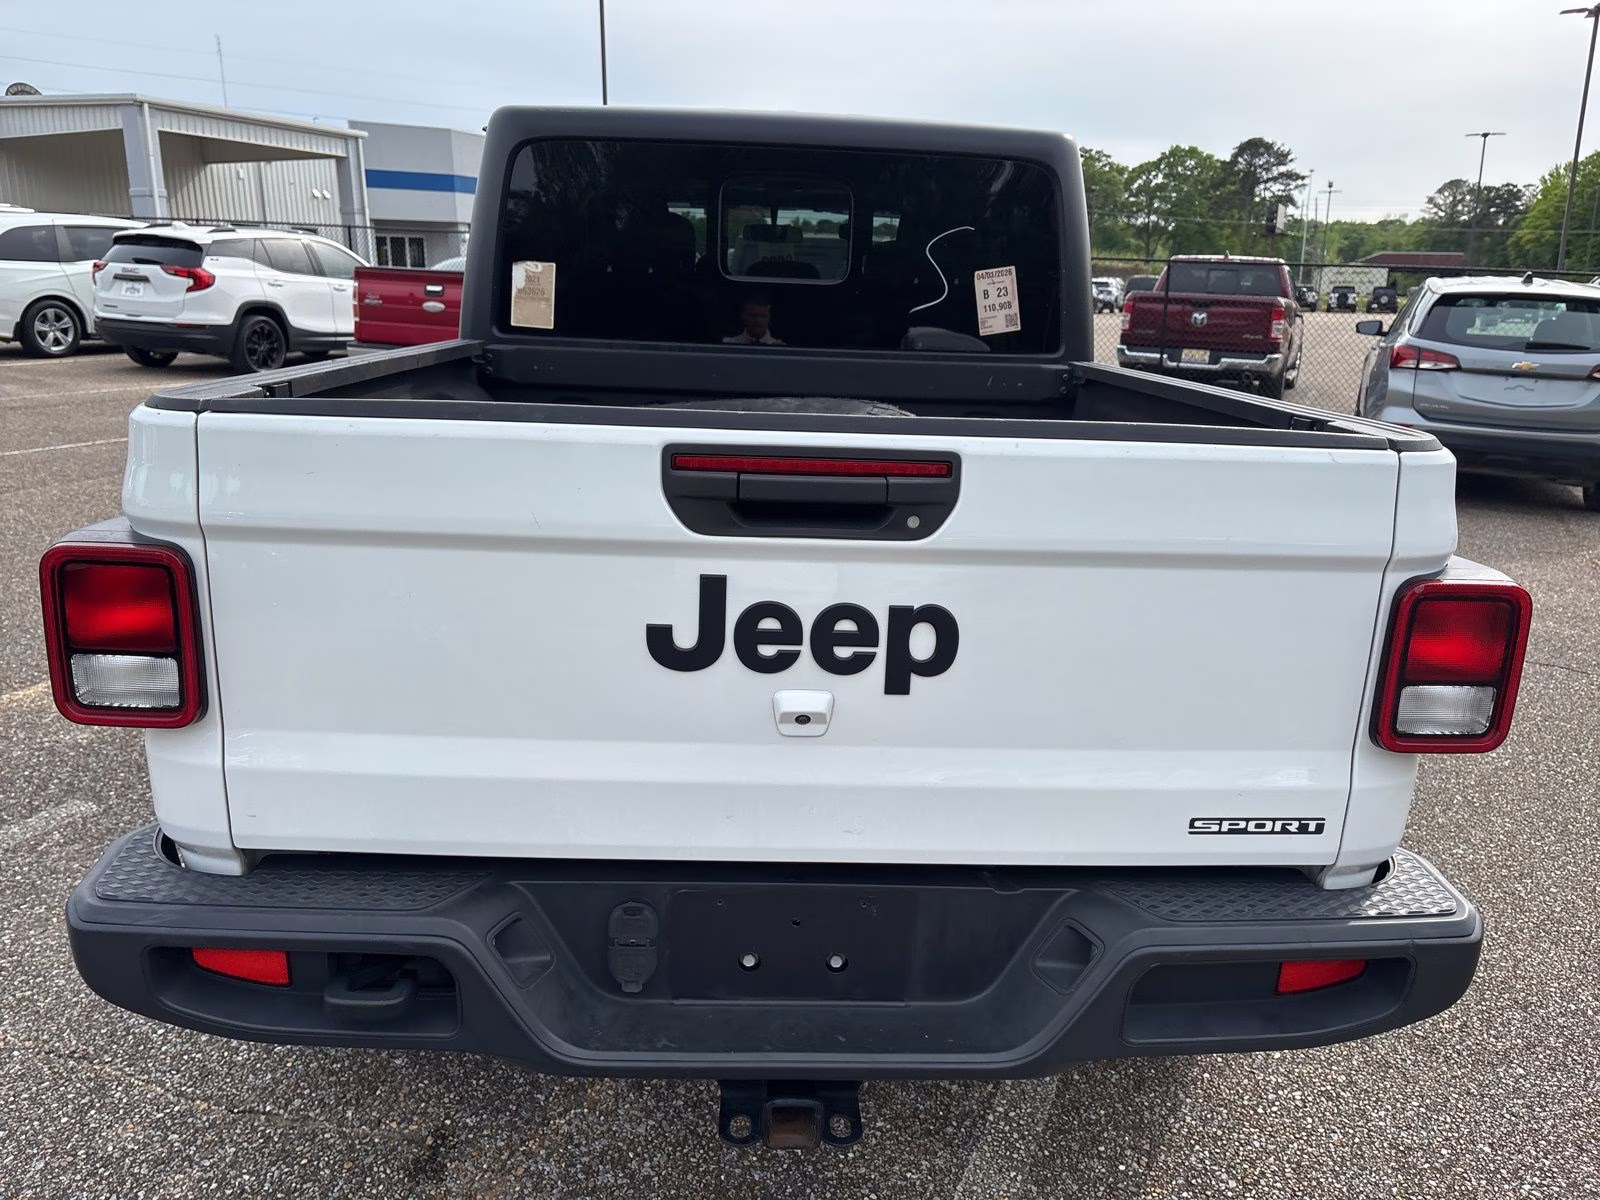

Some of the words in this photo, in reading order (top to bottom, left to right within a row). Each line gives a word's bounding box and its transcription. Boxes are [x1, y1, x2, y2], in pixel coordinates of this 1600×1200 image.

[983, 289, 990, 299] B
[996, 287, 1008, 297] 23
[646, 573, 960, 695] Jeep
[1188, 818, 1326, 834] SPORT
